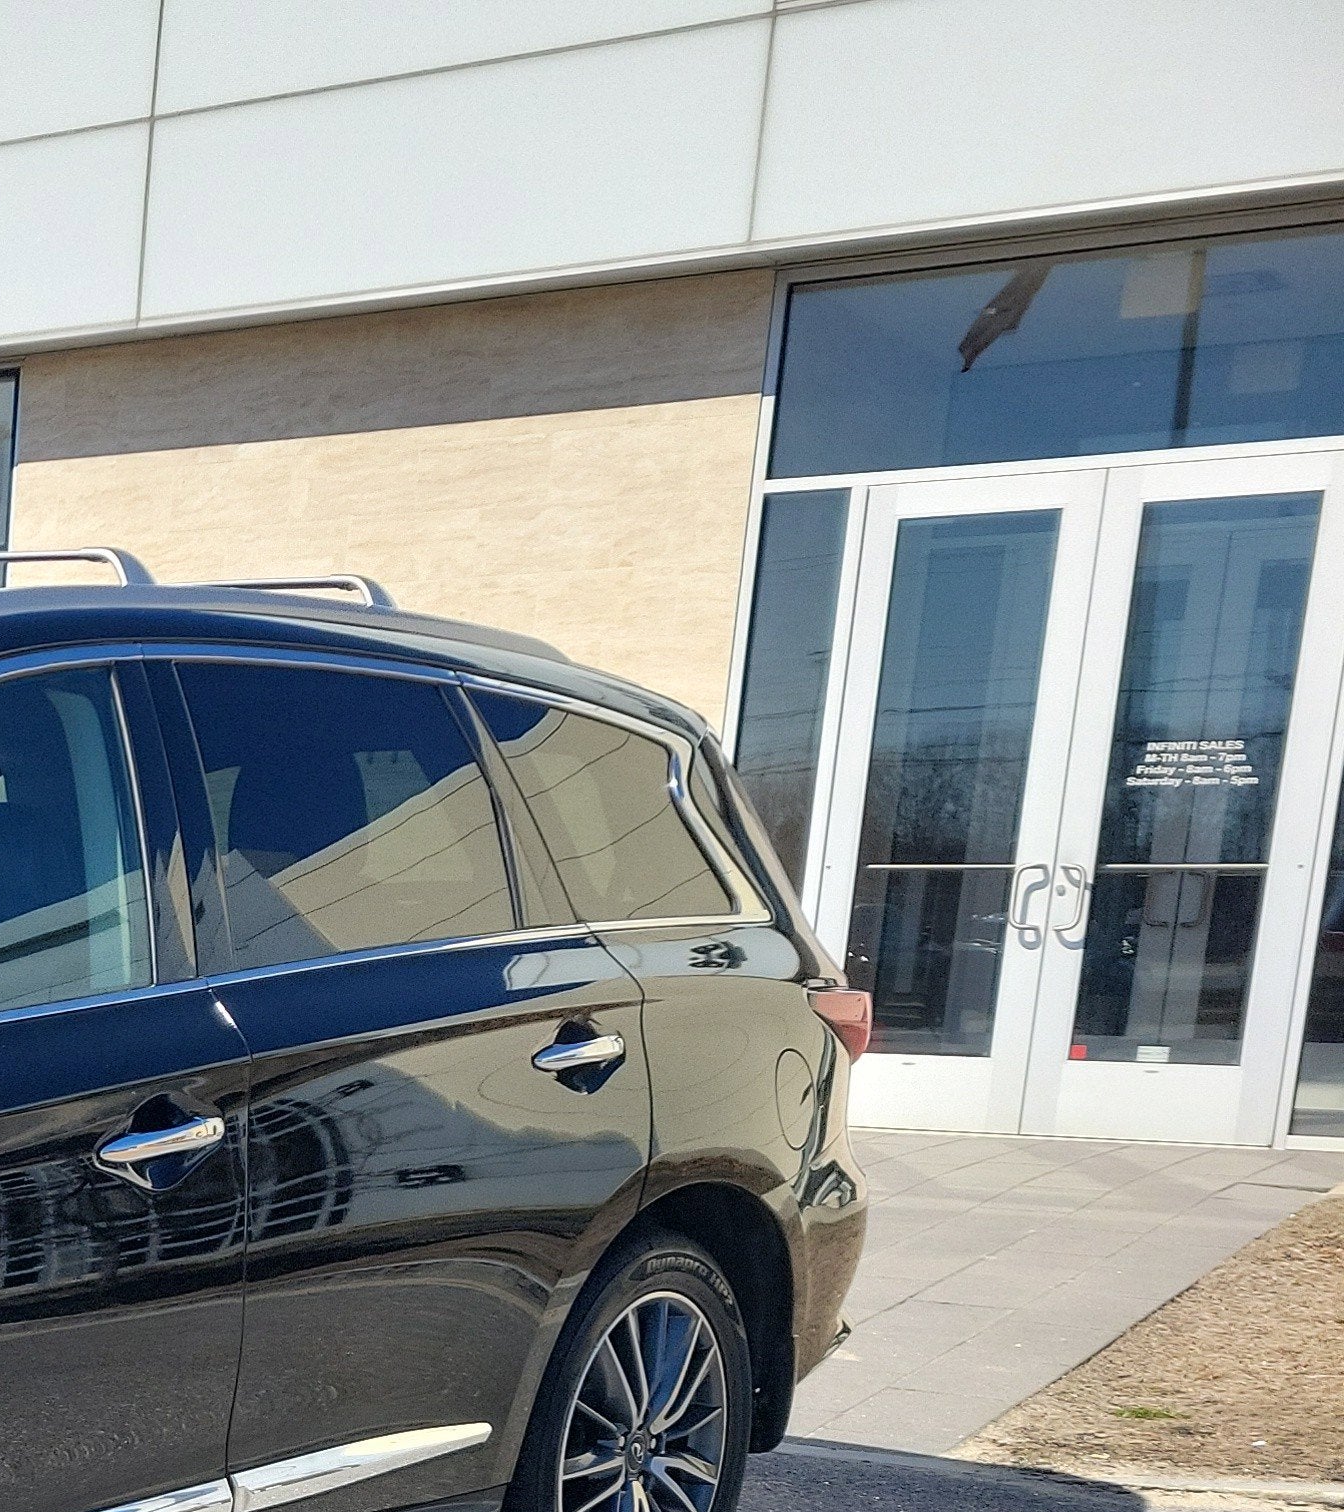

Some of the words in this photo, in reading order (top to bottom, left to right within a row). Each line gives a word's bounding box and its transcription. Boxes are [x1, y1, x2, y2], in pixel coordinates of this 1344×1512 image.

[1146, 740, 1197, 751] INFINITI
[1199, 740, 1245, 750] SALES
[1218, 752, 1247, 763] 7pm
[1136, 765, 1177, 776] Friday
[1126, 776, 1183, 787] Saturday
